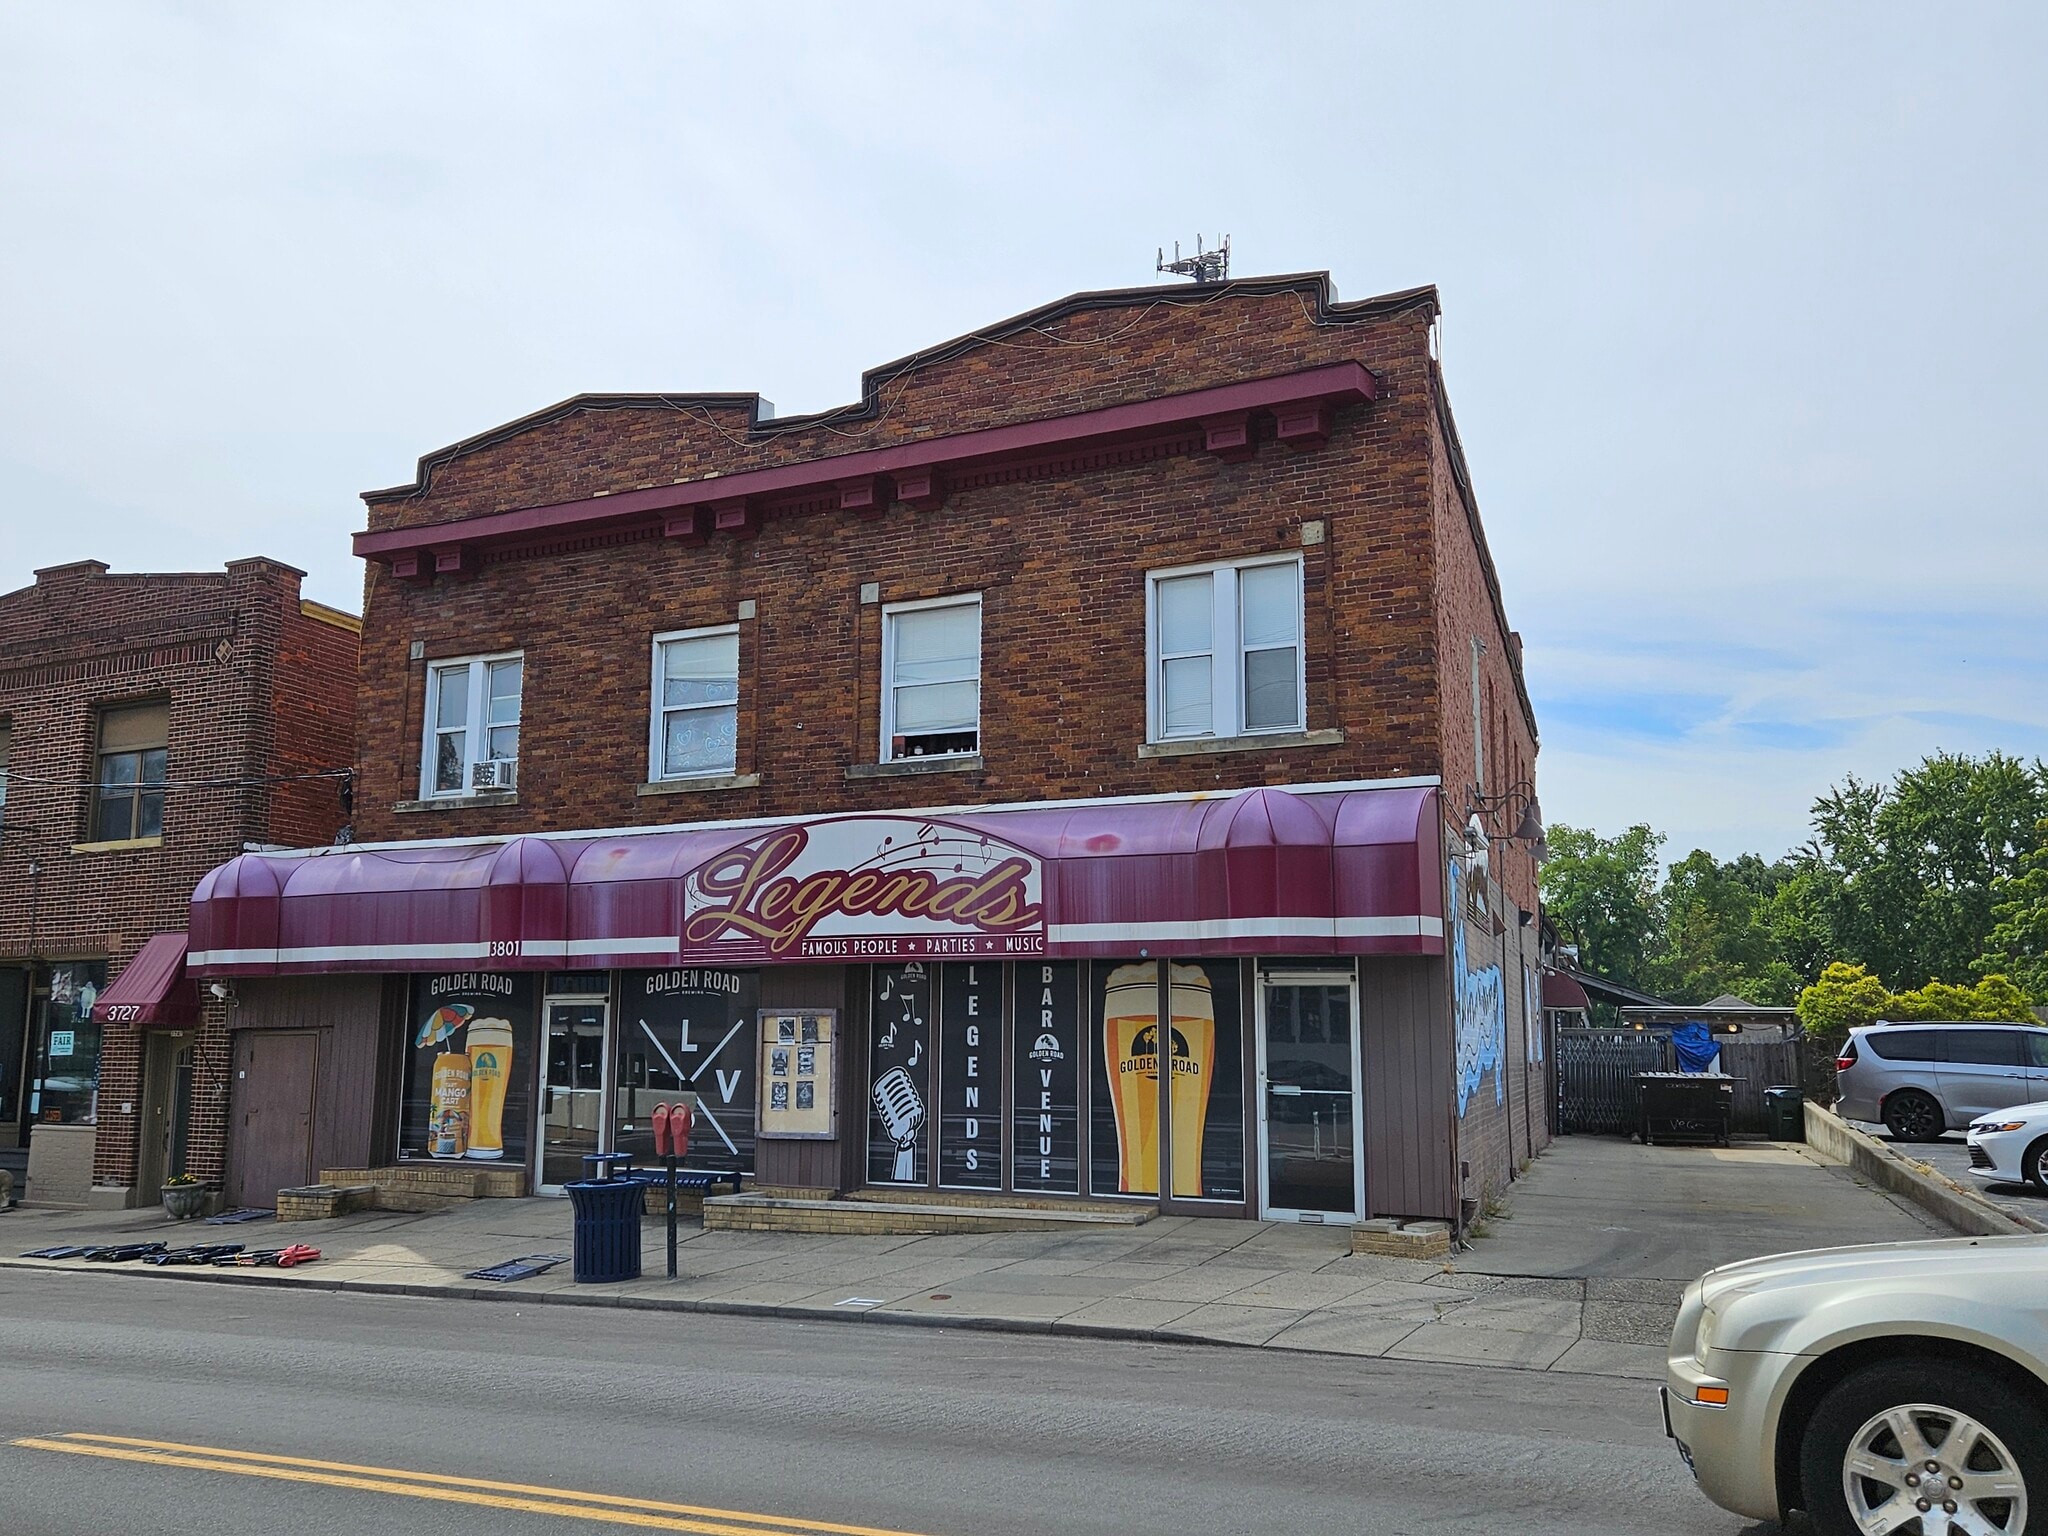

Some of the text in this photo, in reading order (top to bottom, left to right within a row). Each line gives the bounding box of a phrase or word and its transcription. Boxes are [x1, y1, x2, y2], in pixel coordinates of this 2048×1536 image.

[685, 832, 1040, 953] Legends
[490, 940, 520, 957] 3801
[801, 937, 1045, 956] FAMOUS PEOPLE PARTIES MUSIC
[430, 973, 513, 996] GOLDEN ROAD
[645, 970, 740, 995] GOLDEN ROAD
[1041, 966, 1054, 1028] BAR
[107, 1005, 140, 1021] 3727
[53, 1036, 72, 1046] FAIR
[681, 1019, 698, 1052] L
[1028, 1049, 1064, 1059] GOLDEN ROAD
[966, 966, 979, 1170] LEGENDS
[1120, 1057, 1199, 1075] GOLDEN ROAD
[435, 1087, 467, 1098] MANGO
[715, 1069, 742, 1104] V
[441, 1097, 460, 1105] CART
[1040, 1069, 1052, 1179] VENUE
